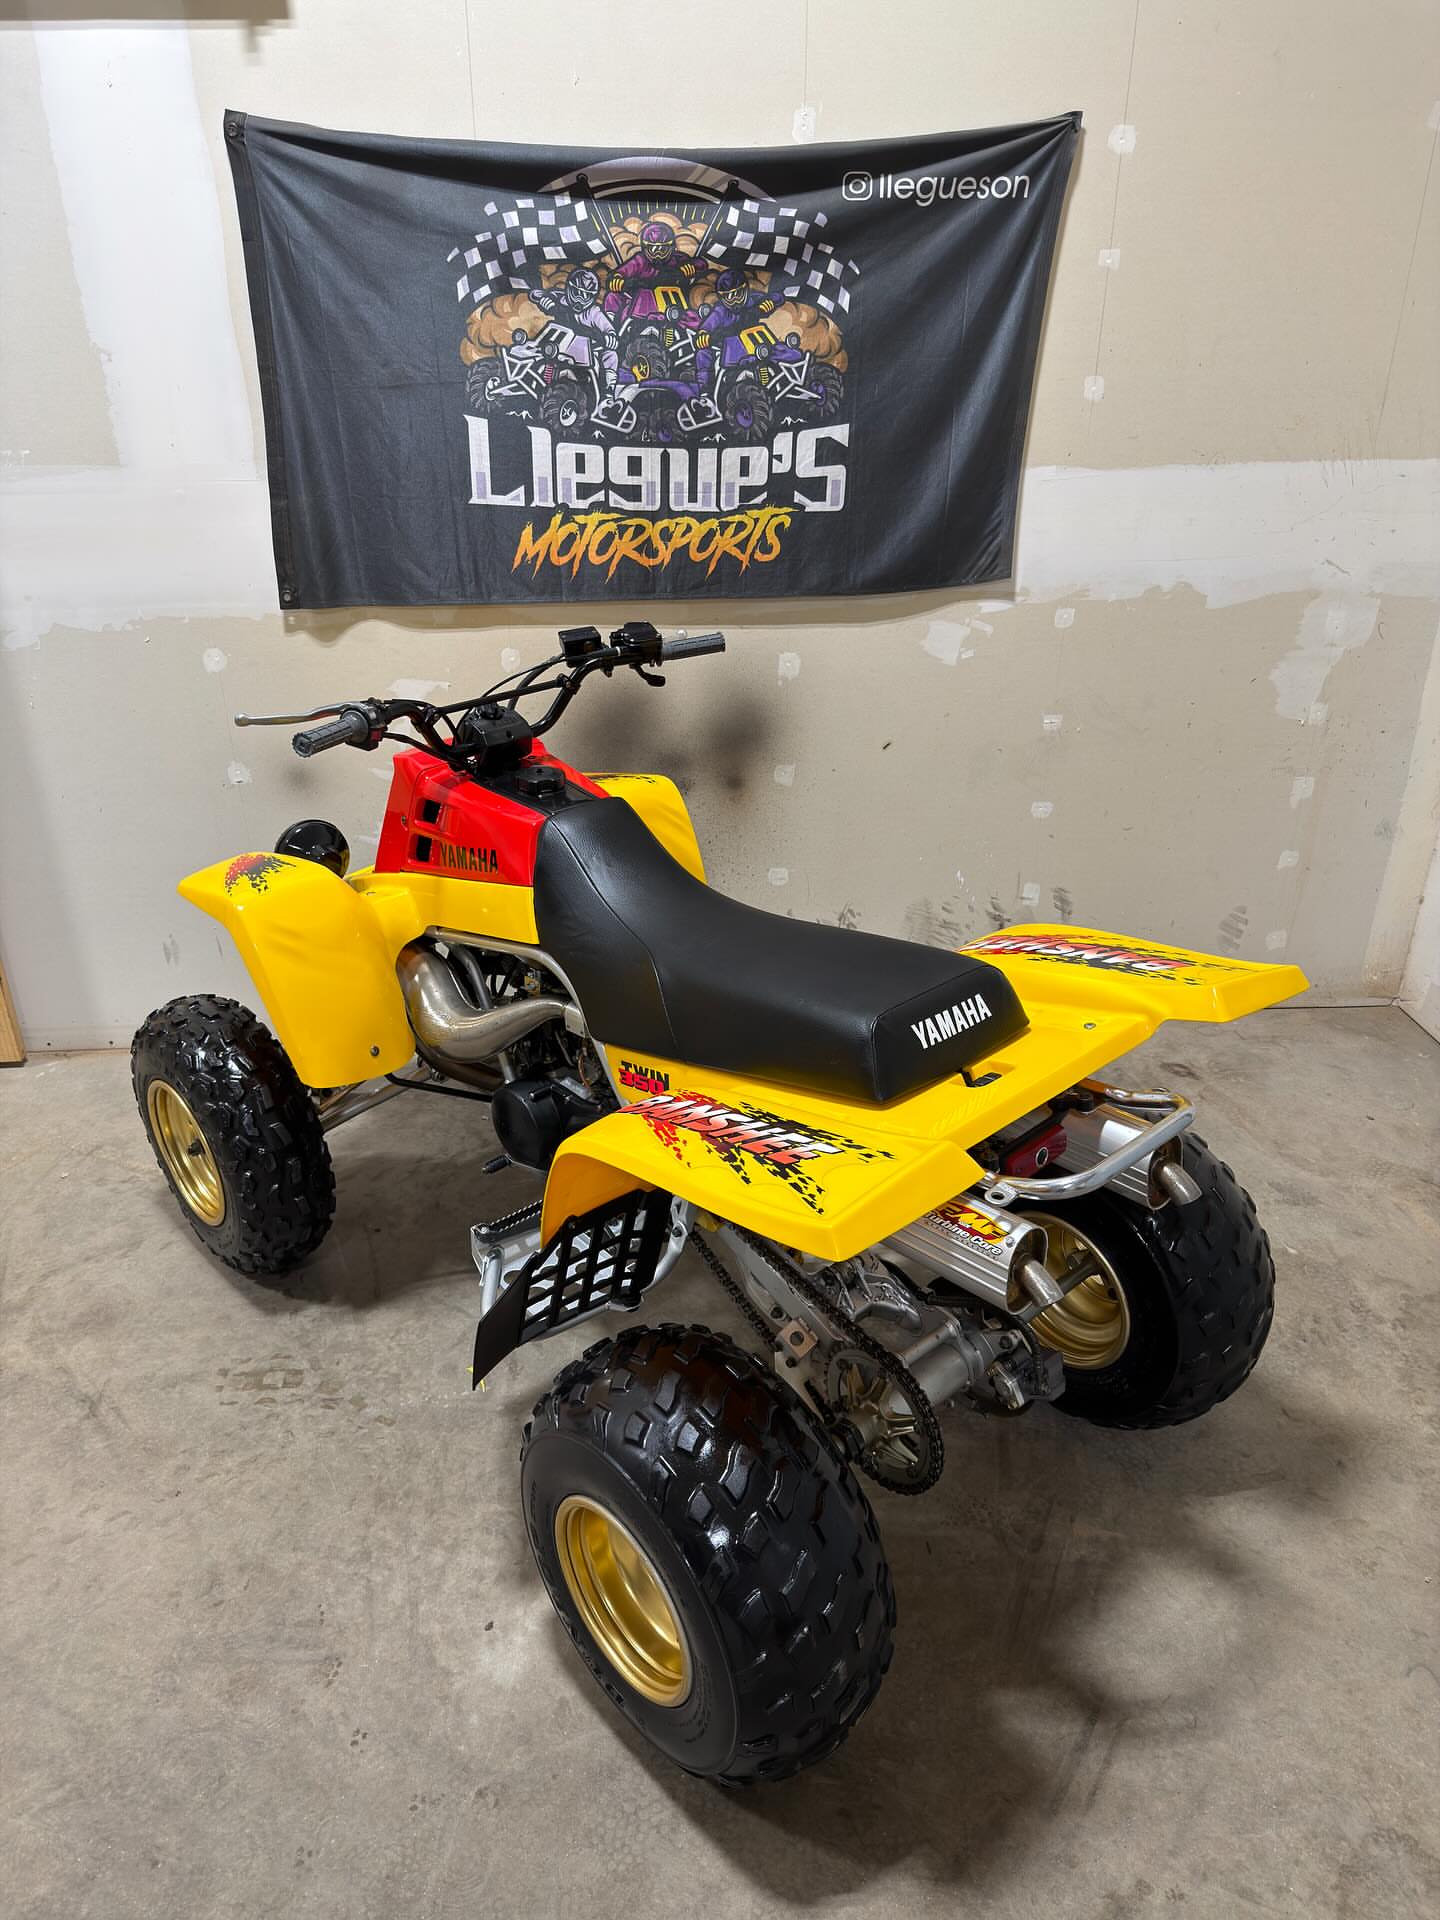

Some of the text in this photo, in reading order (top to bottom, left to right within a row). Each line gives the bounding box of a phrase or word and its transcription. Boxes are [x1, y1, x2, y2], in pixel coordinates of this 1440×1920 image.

[879, 174, 1030, 207] llegueson
[511, 503, 801, 584] MOTORSPORTS
[440, 841, 498, 873] YAMAHA
[910, 993, 993, 1049] YAMAHA
[618, 1067, 665, 1096] 350
[621, 1060, 670, 1091] TWIN
[616, 1094, 845, 1166] BANSHEE
[937, 1200, 1010, 1240] FMF
[970, 1234, 1003, 1256] Core
